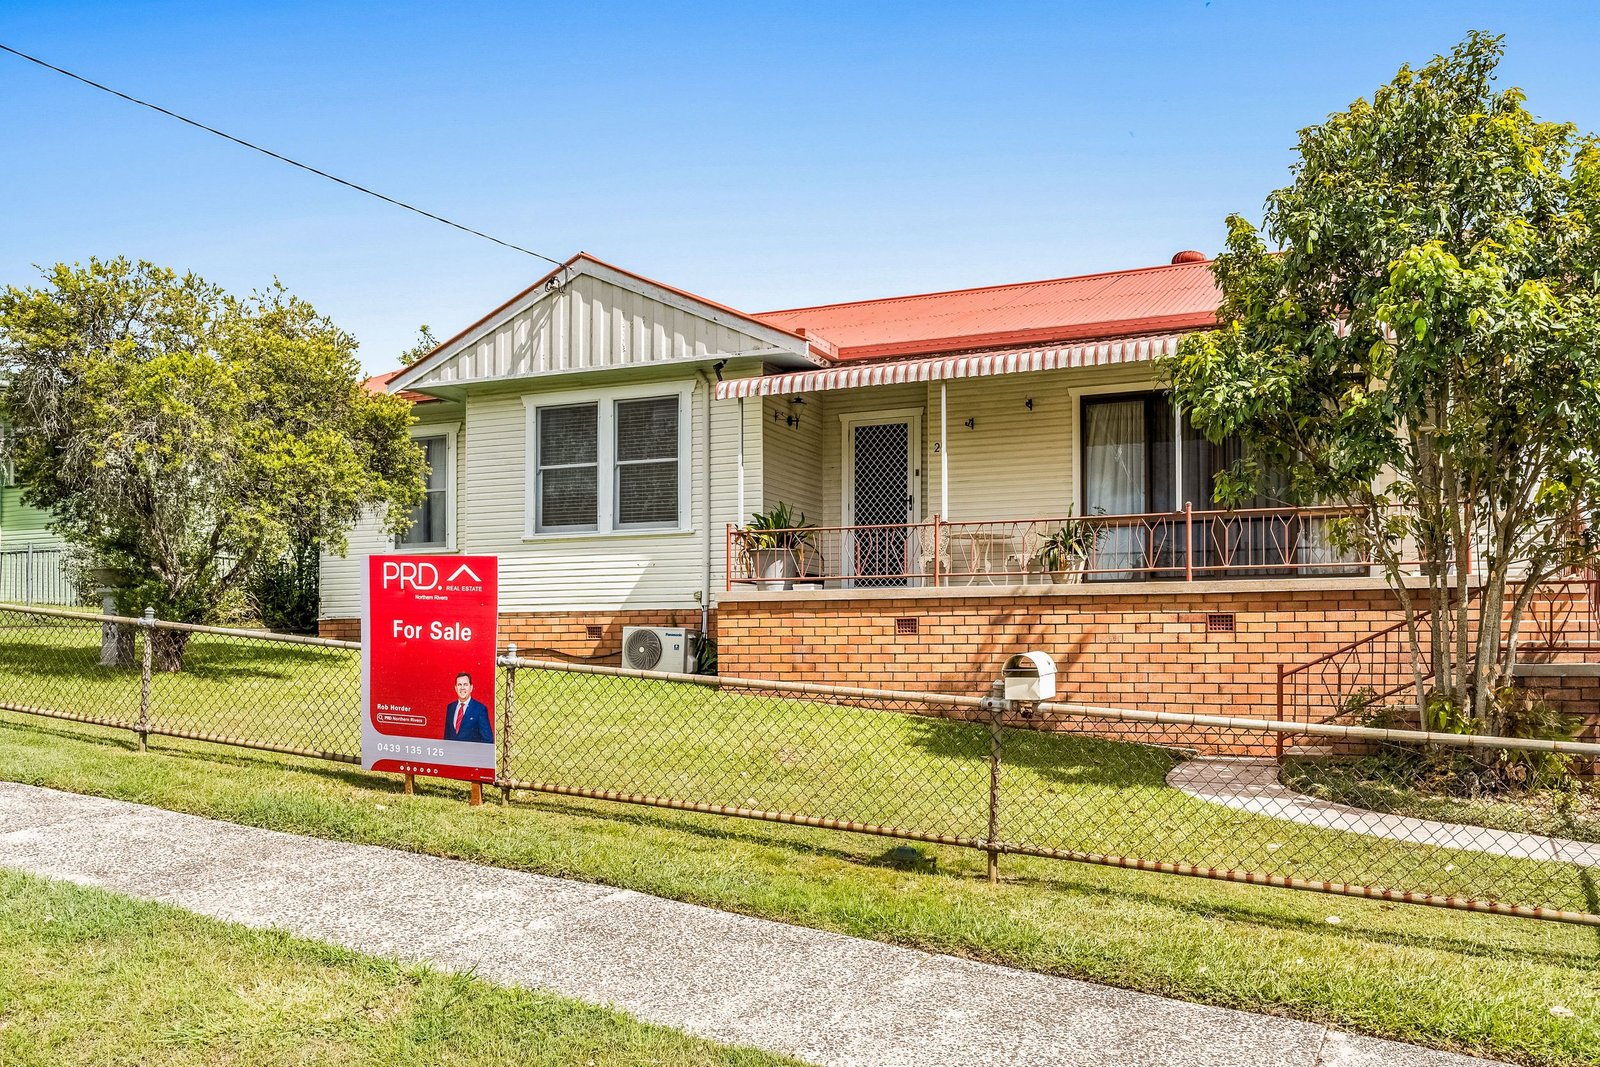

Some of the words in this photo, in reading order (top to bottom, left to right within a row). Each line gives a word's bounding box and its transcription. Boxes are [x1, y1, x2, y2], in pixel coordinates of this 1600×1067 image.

[383, 562, 442, 590] PRD.
[393, 620, 422, 639] For
[430, 621, 471, 641] Sale
[377, 743, 401, 752] 0439
[405, 745, 422, 754] 135
[427, 747, 444, 756] 125
